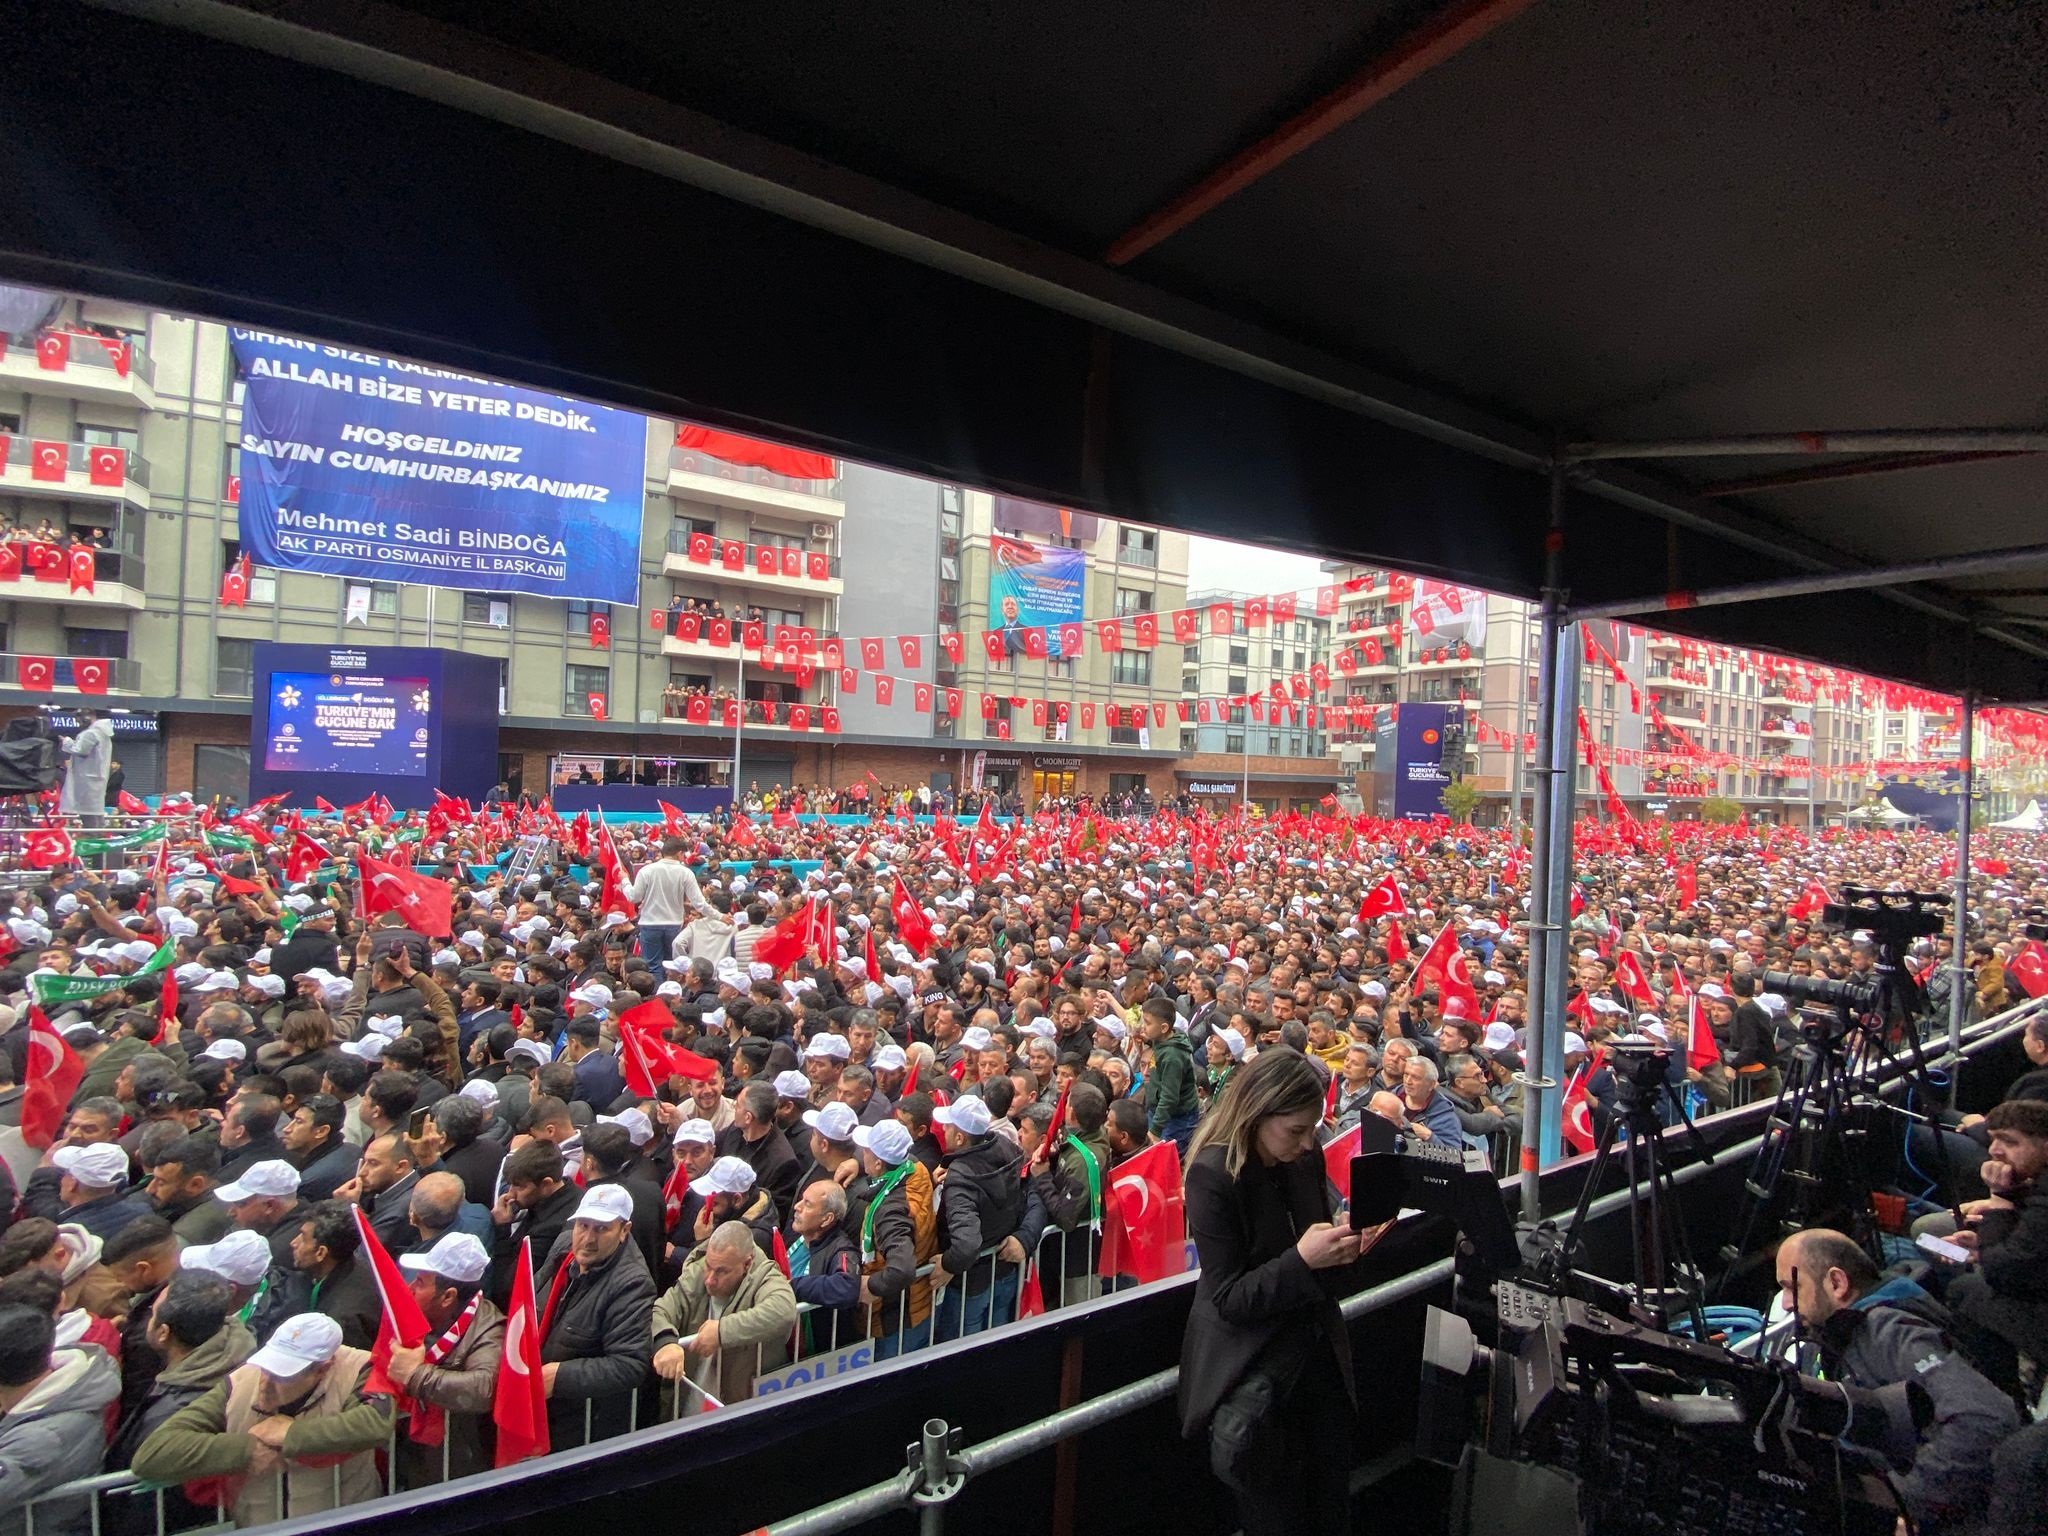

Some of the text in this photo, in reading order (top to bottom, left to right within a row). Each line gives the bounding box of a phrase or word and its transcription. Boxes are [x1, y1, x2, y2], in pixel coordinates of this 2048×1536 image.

[252, 357, 597, 433] ALLAH BİZE YETER DEDİK.
[241, 433, 610, 502] SAYIN CUMHURBAŞKANIMIZ
[278, 507, 566, 557] Mehmet Sadi BİNBOĞA
[280, 535, 564, 577] AK PARTİ OSMANİYE İL BAŞKANI
[368, 718, 396, 729] BAK
[1042, 757, 1082, 767] MOONLIGHT
[925, 992, 944, 1004] KING
[1423, 1175, 1449, 1185] SWIT
[1757, 1469, 1807, 1490] SONY
